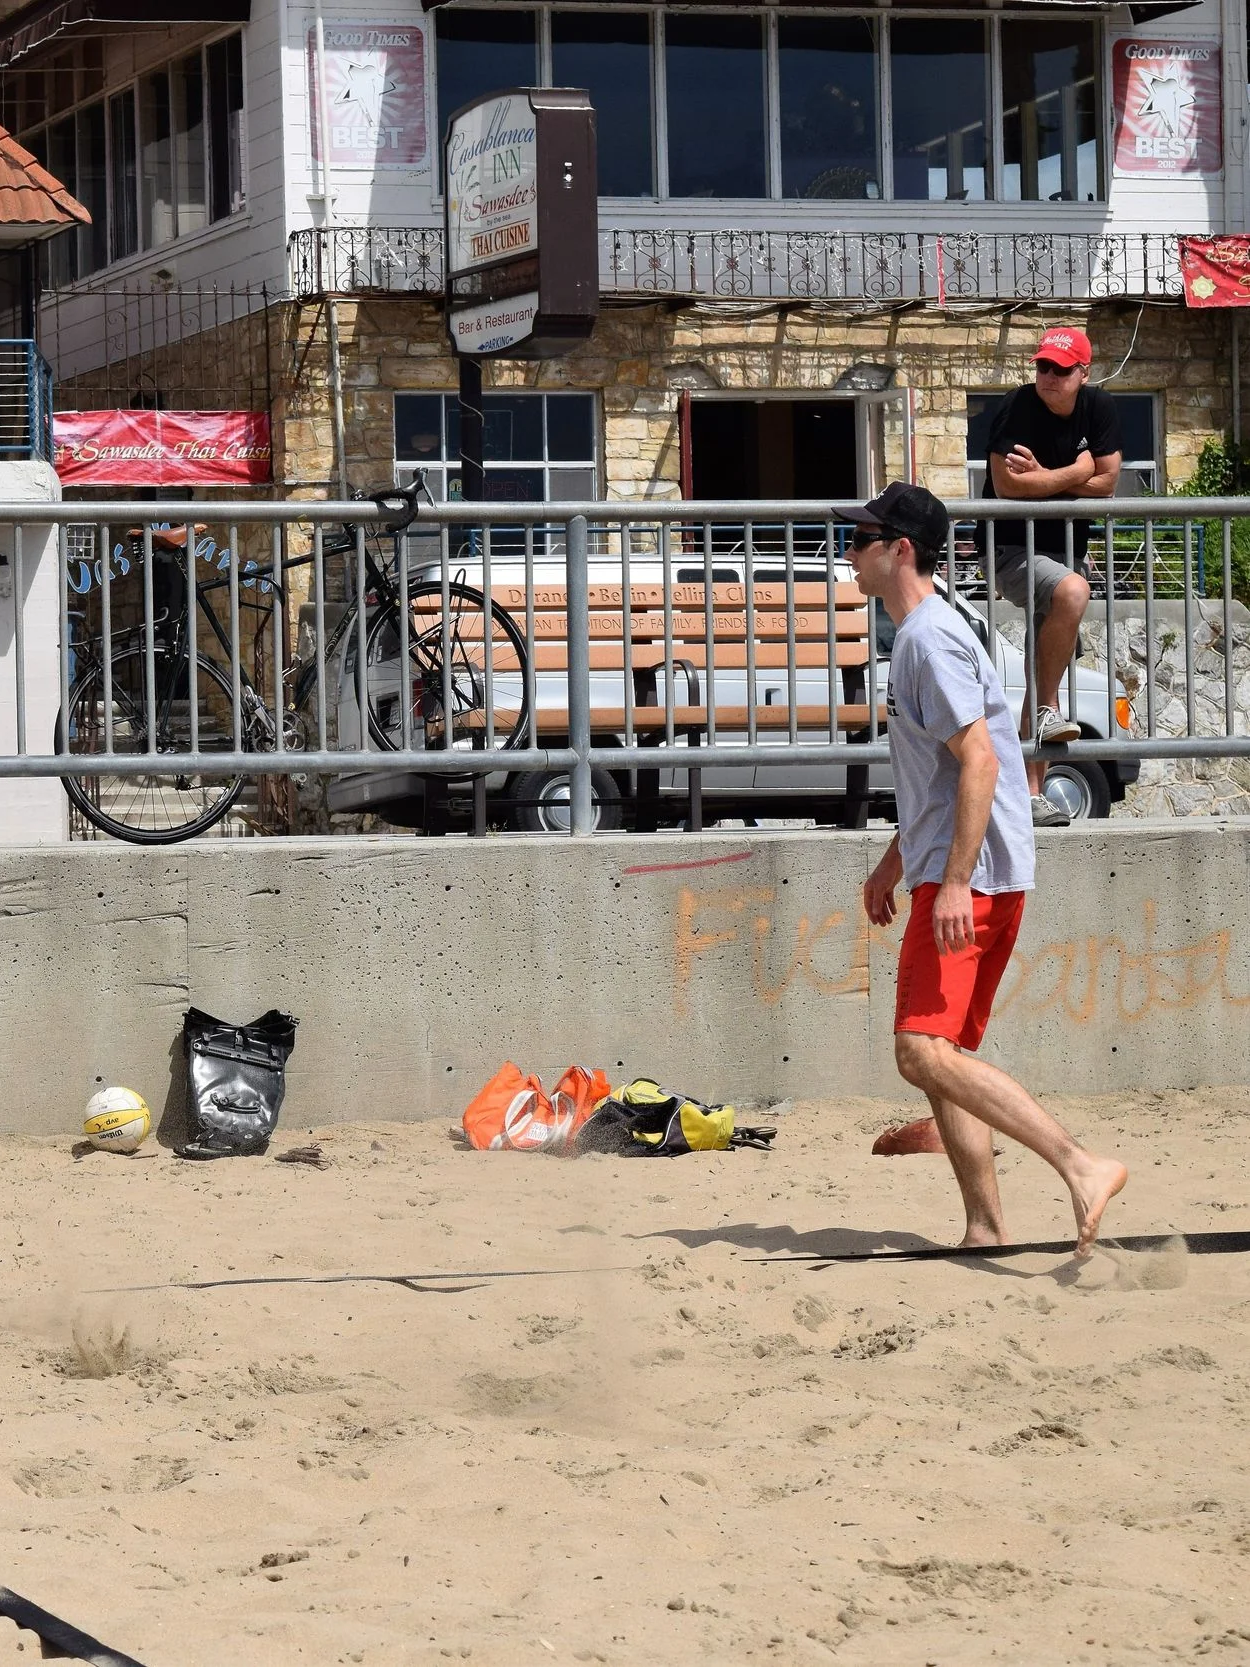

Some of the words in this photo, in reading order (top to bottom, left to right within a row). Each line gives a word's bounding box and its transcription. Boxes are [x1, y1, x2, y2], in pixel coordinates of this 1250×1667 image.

[332, 125, 404, 149] BEST
[449, 98, 535, 176] Casablanca
[1135, 136, 1203, 160] BEST
[492, 145, 522, 184] INN
[471, 233, 493, 259] THAI
[494, 222, 530, 252] CUISINE
[458, 321, 474, 335] Bar
[475, 318, 483, 331] &
[485, 306, 534, 329] Restaurant
[484, 335, 510, 351] PARKING
[78, 439, 165, 462] Sawasdee
[172, 441, 219, 460] Thai
[726, 587, 773, 601] Clns
[755, 617, 766, 629] &
